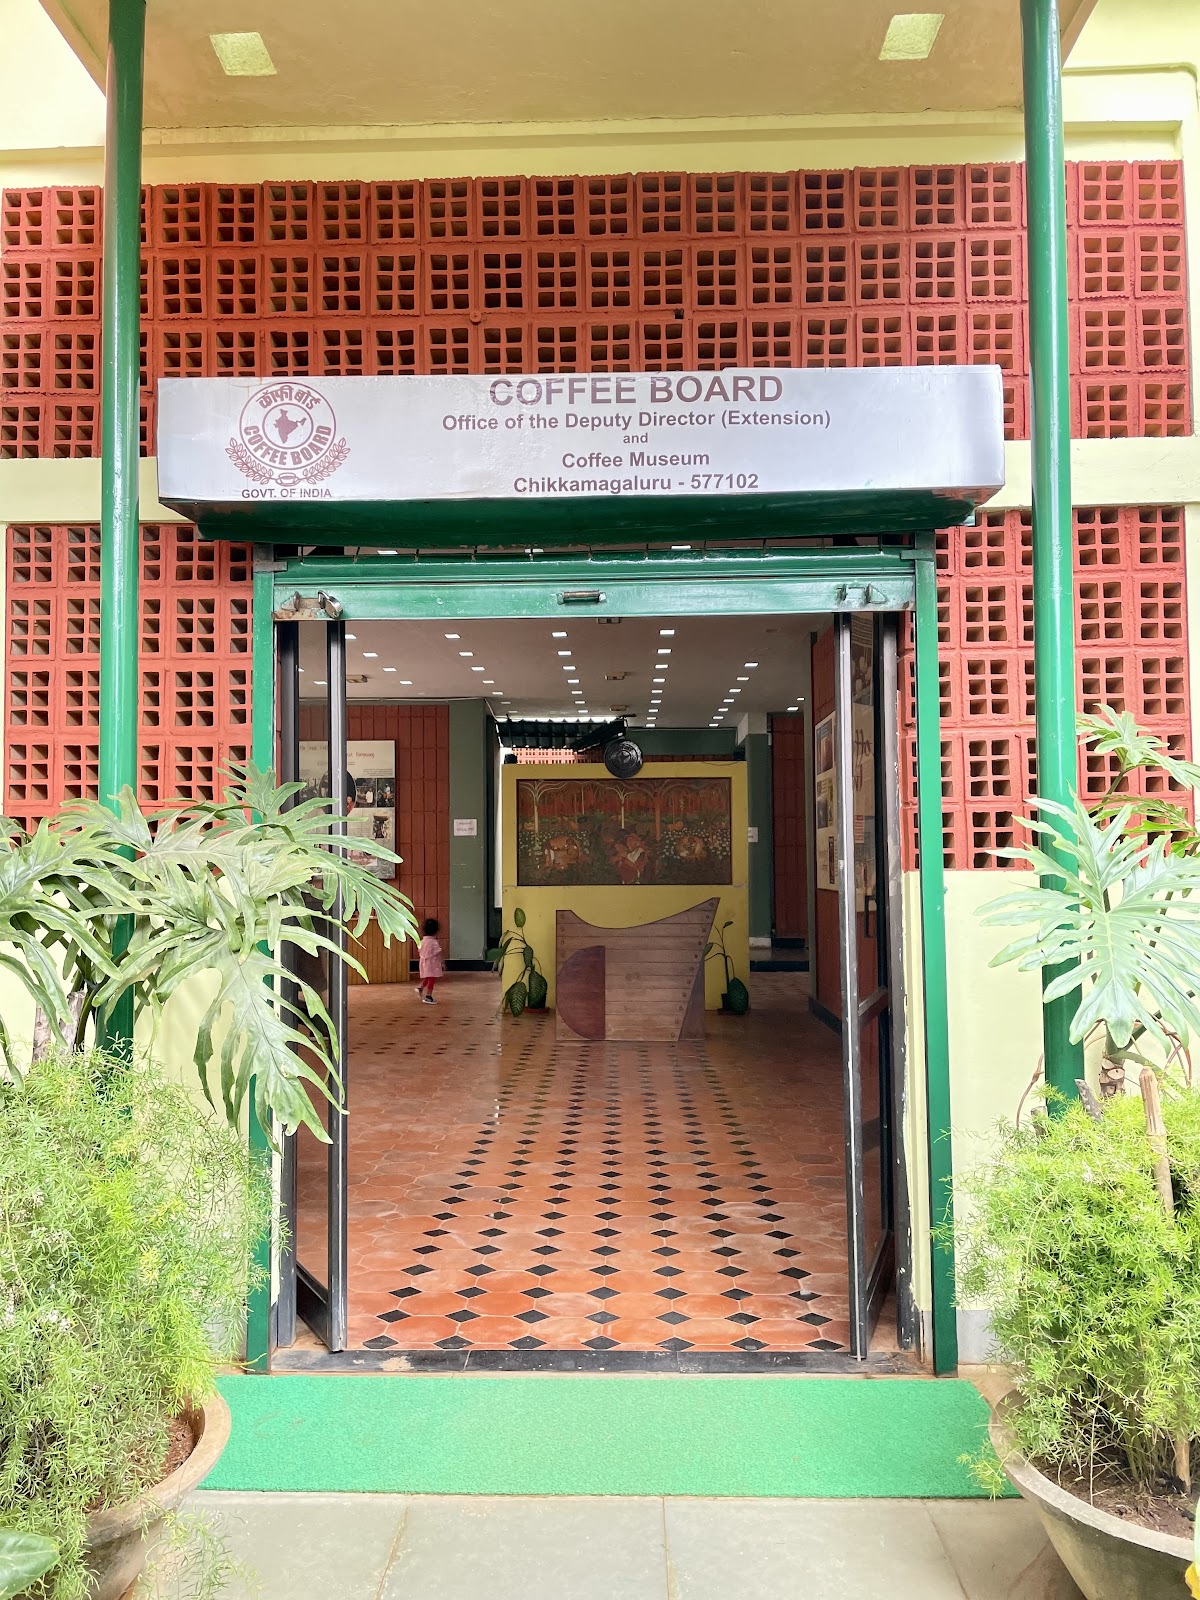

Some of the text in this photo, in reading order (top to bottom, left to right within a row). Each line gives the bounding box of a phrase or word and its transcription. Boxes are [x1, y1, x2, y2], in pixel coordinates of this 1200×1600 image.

[489, 375, 783, 406] COFFEE BOARD
[442, 409, 831, 431] Office of the Deputy Director (Extension)
[243, 425, 332, 466] COFFEE BOARD
[622, 432, 649, 444] and
[561, 451, 710, 469] Coffee Museum
[241, 488, 332, 499] GOVT. OF INDIA
[513, 475, 672, 495] Chikkamagaluru
[690, 473, 759, 490] 577102
